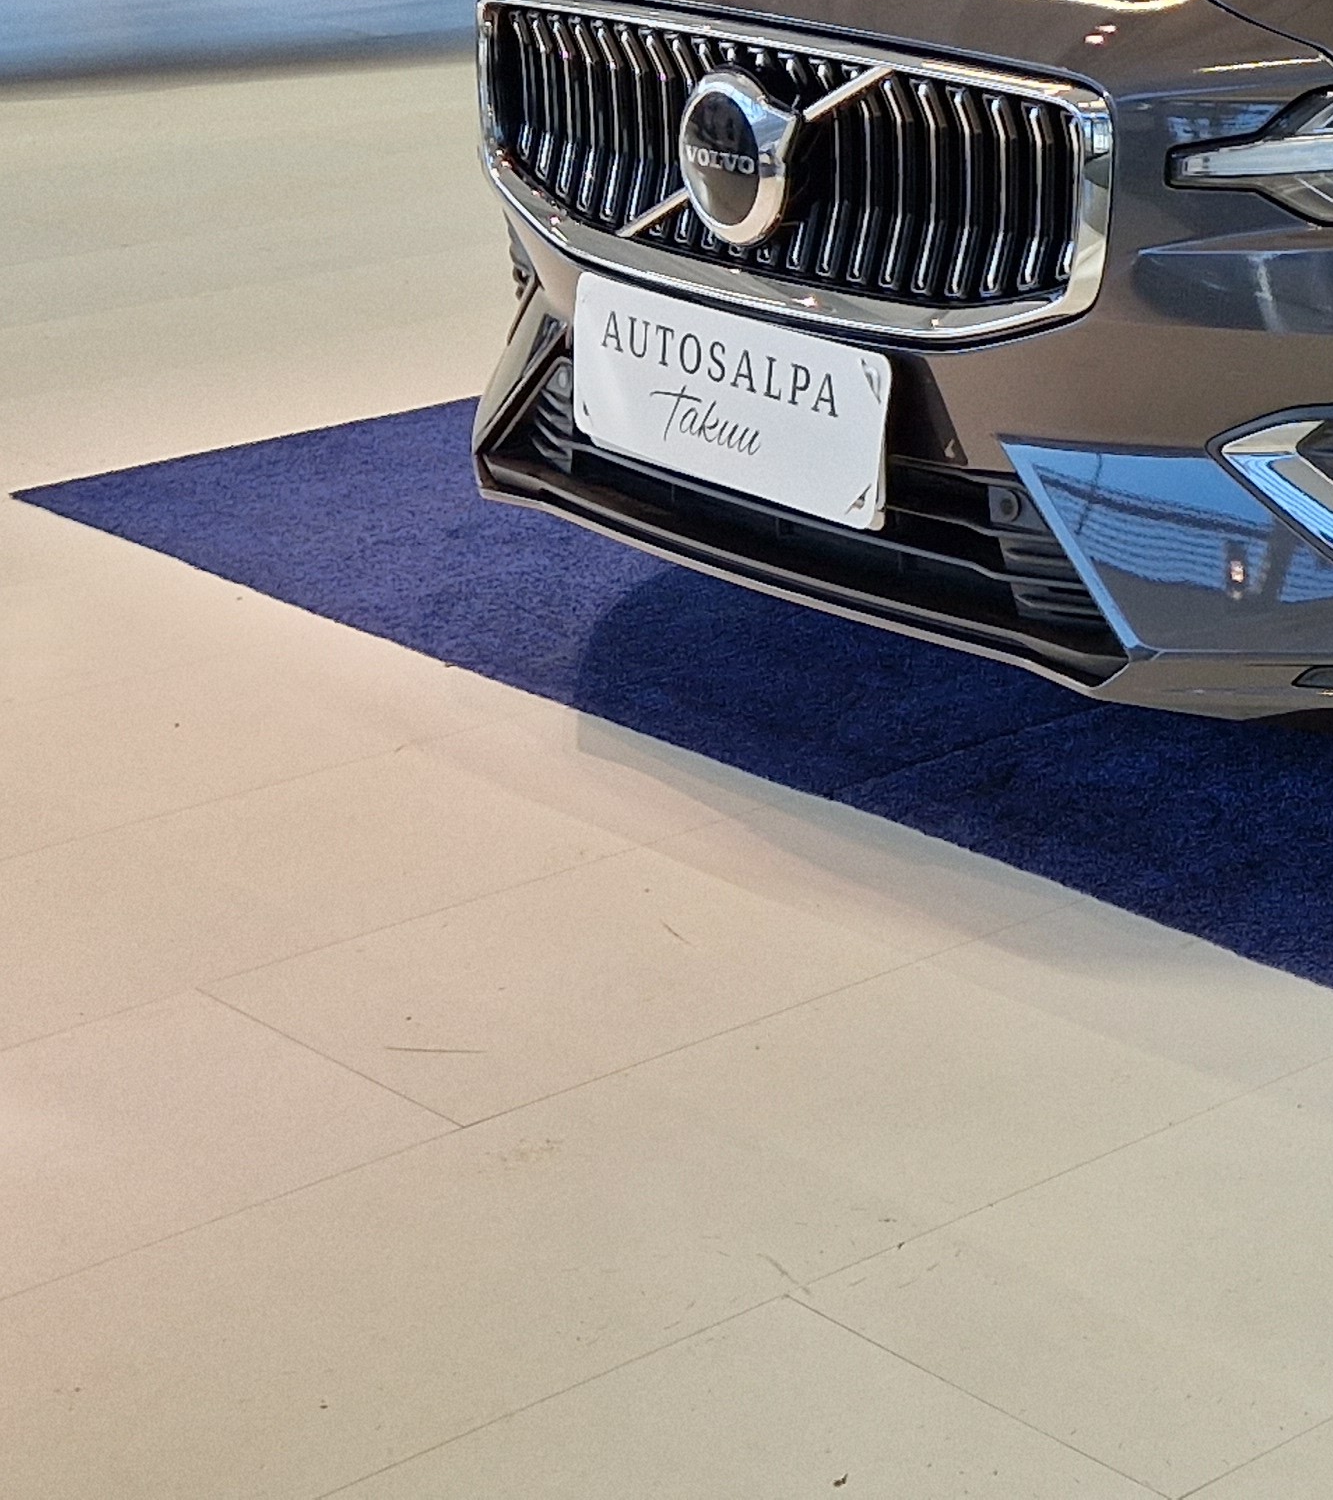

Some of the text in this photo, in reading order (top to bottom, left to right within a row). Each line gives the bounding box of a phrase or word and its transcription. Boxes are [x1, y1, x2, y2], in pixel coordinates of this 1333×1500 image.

[685, 144, 755, 175] VOLVO
[601, 311, 839, 418] AUTOSALPA
[650, 385, 761, 456] Takuu
